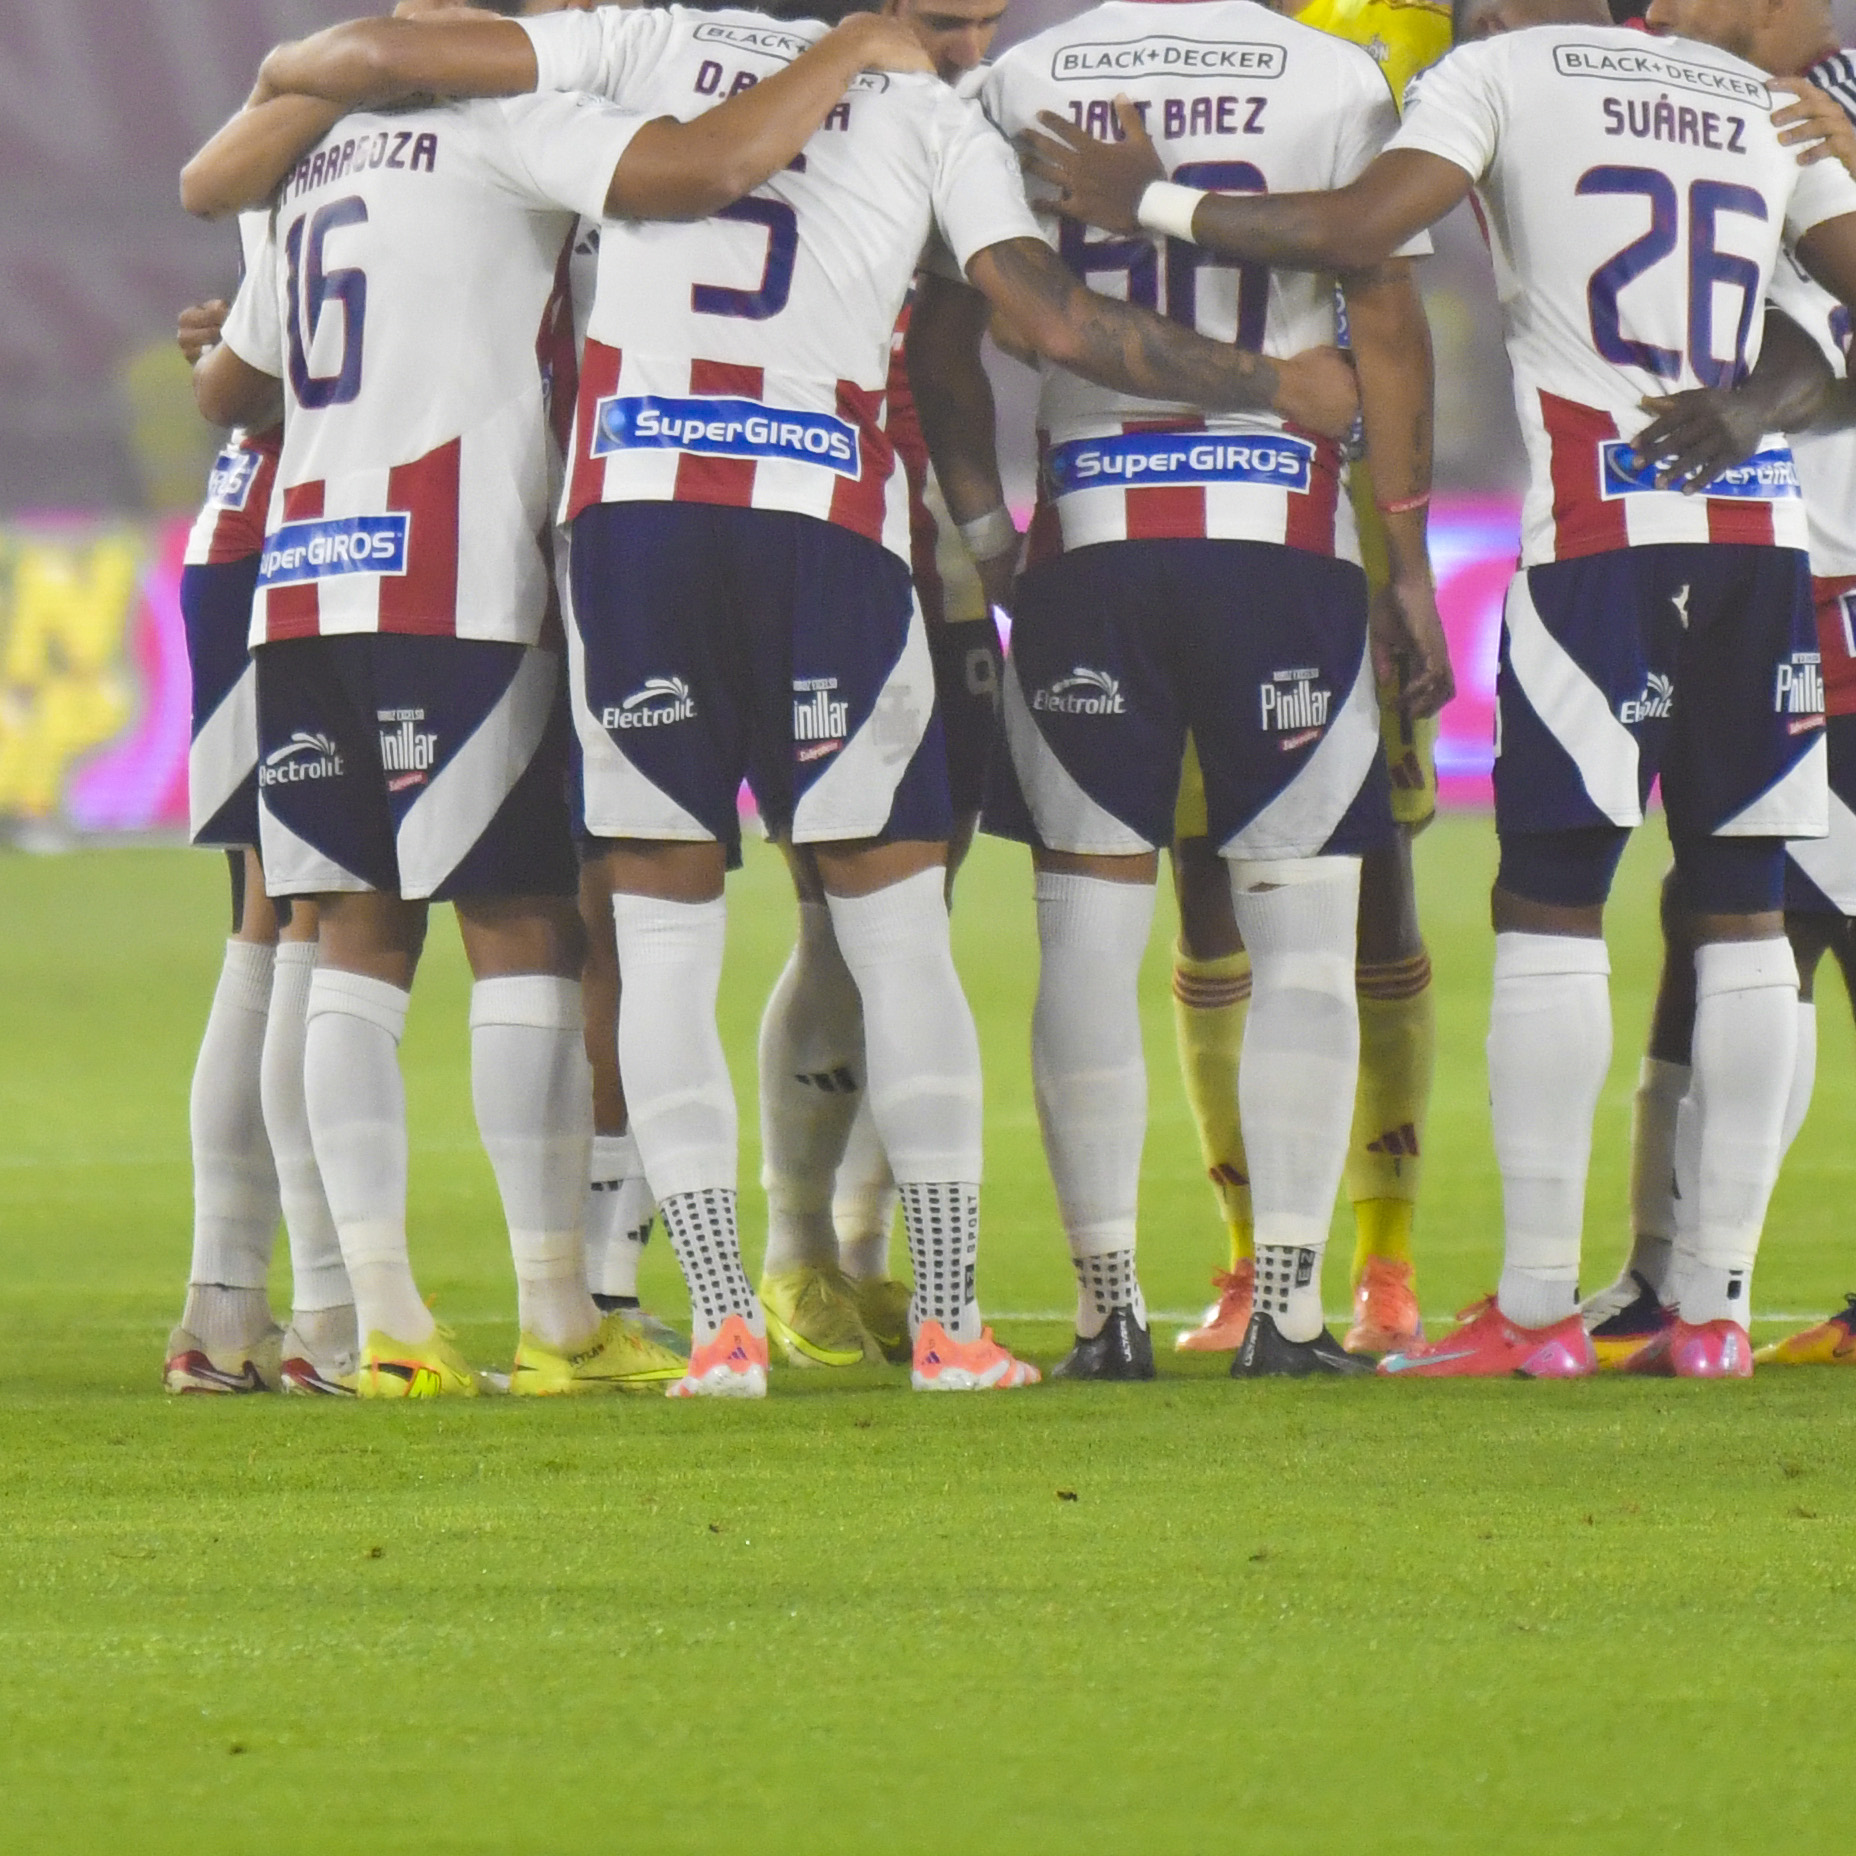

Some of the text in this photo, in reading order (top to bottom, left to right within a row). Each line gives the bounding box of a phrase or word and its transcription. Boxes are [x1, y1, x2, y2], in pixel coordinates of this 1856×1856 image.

[1063, 46, 1275, 72] BLACK+DECKER
[1564, 51, 1766, 100] BLACK+DECKER
[1164, 95, 1268, 141] BAEZ
[1602, 92, 1747, 155] SUÁREZ
[1574, 163, 1769, 391] 26
[284, 194, 369, 411] 16
[634, 409, 852, 461] SuperGIROS
[1075, 445, 1301, 479] SuperGIROS
[259, 531, 395, 579] uperGIROS
[602, 696, 696, 730] Electrolit
[793, 691, 849, 741] inillar
[1260, 680, 1332, 731] Pinillar
[379, 721, 438, 771] inillar
